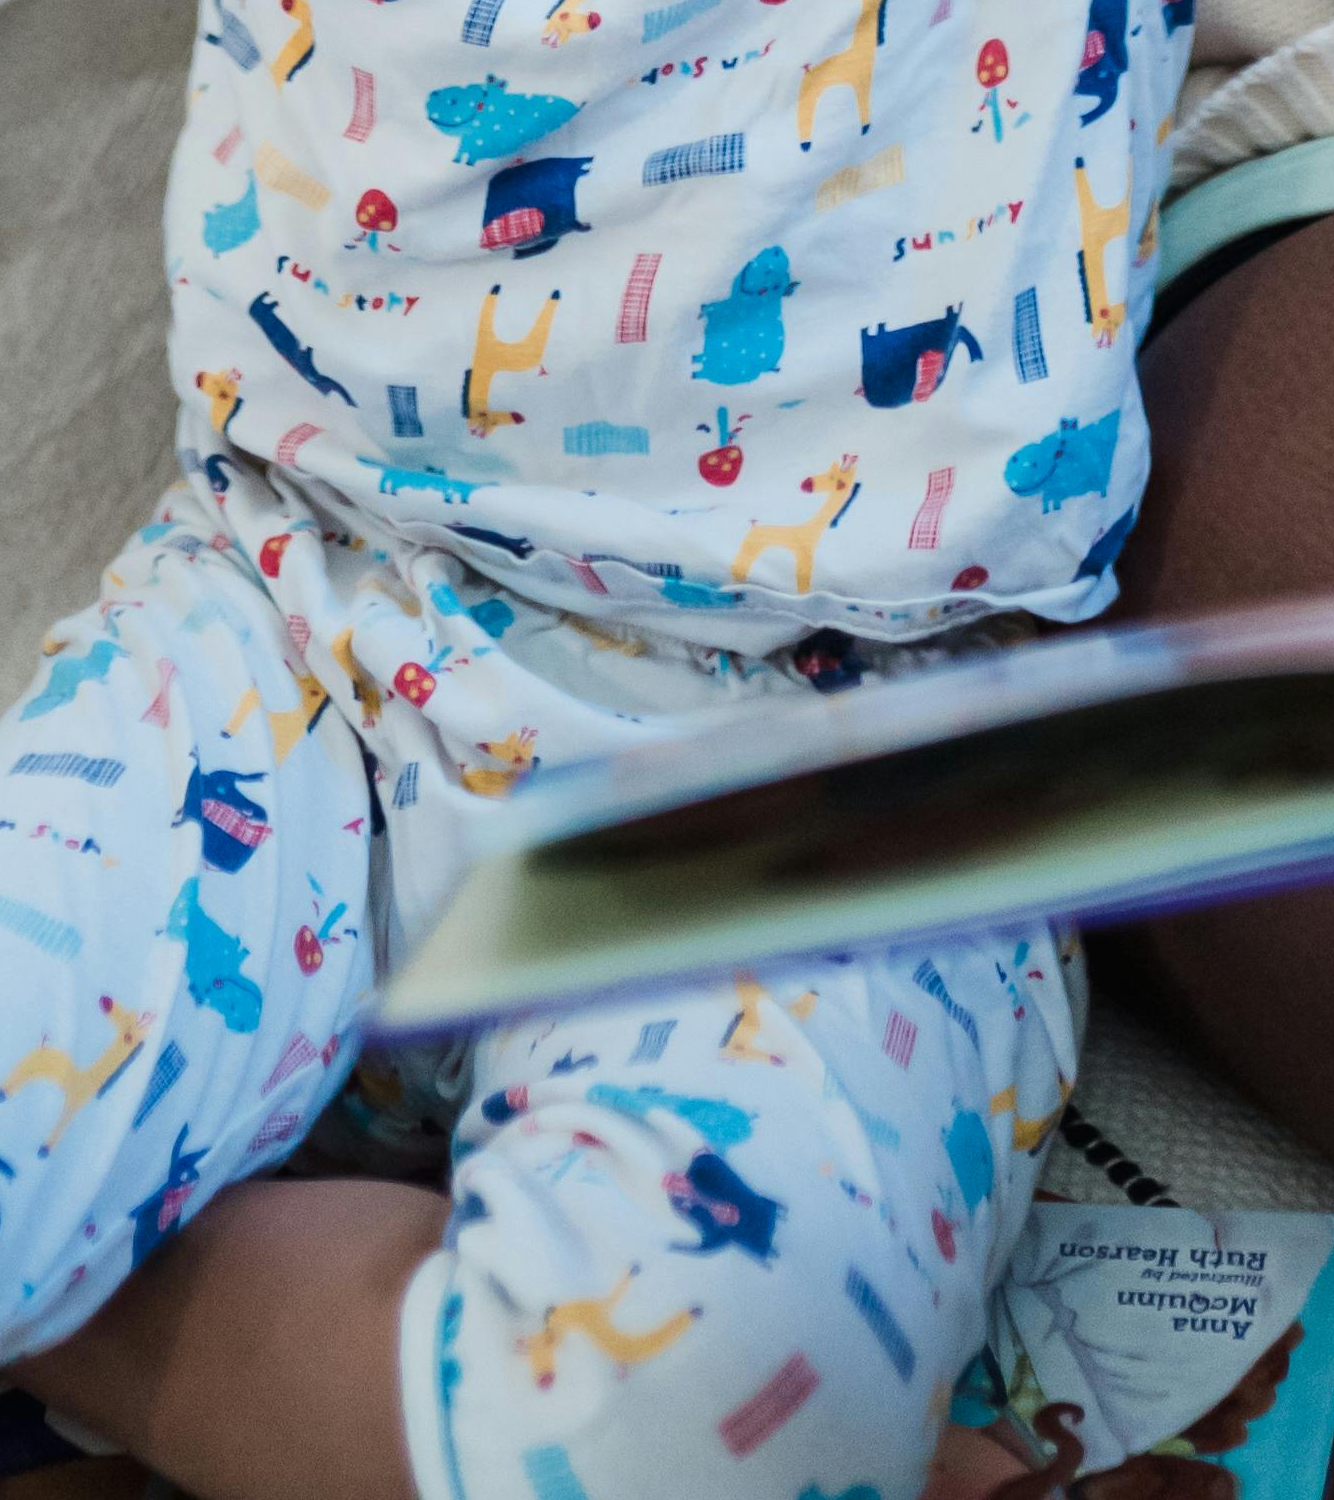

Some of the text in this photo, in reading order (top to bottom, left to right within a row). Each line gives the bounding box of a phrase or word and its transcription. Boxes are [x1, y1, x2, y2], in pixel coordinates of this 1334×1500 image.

[892, 230, 955, 263] sun
[336, 292, 421, 317] story
[1058, 1243, 1267, 1271] Ruth Hearson
[1140, 1268, 1164, 1282] by
[1117, 1291, 1258, 1316] McQuinn
[1172, 1318, 1252, 1341] Anna
